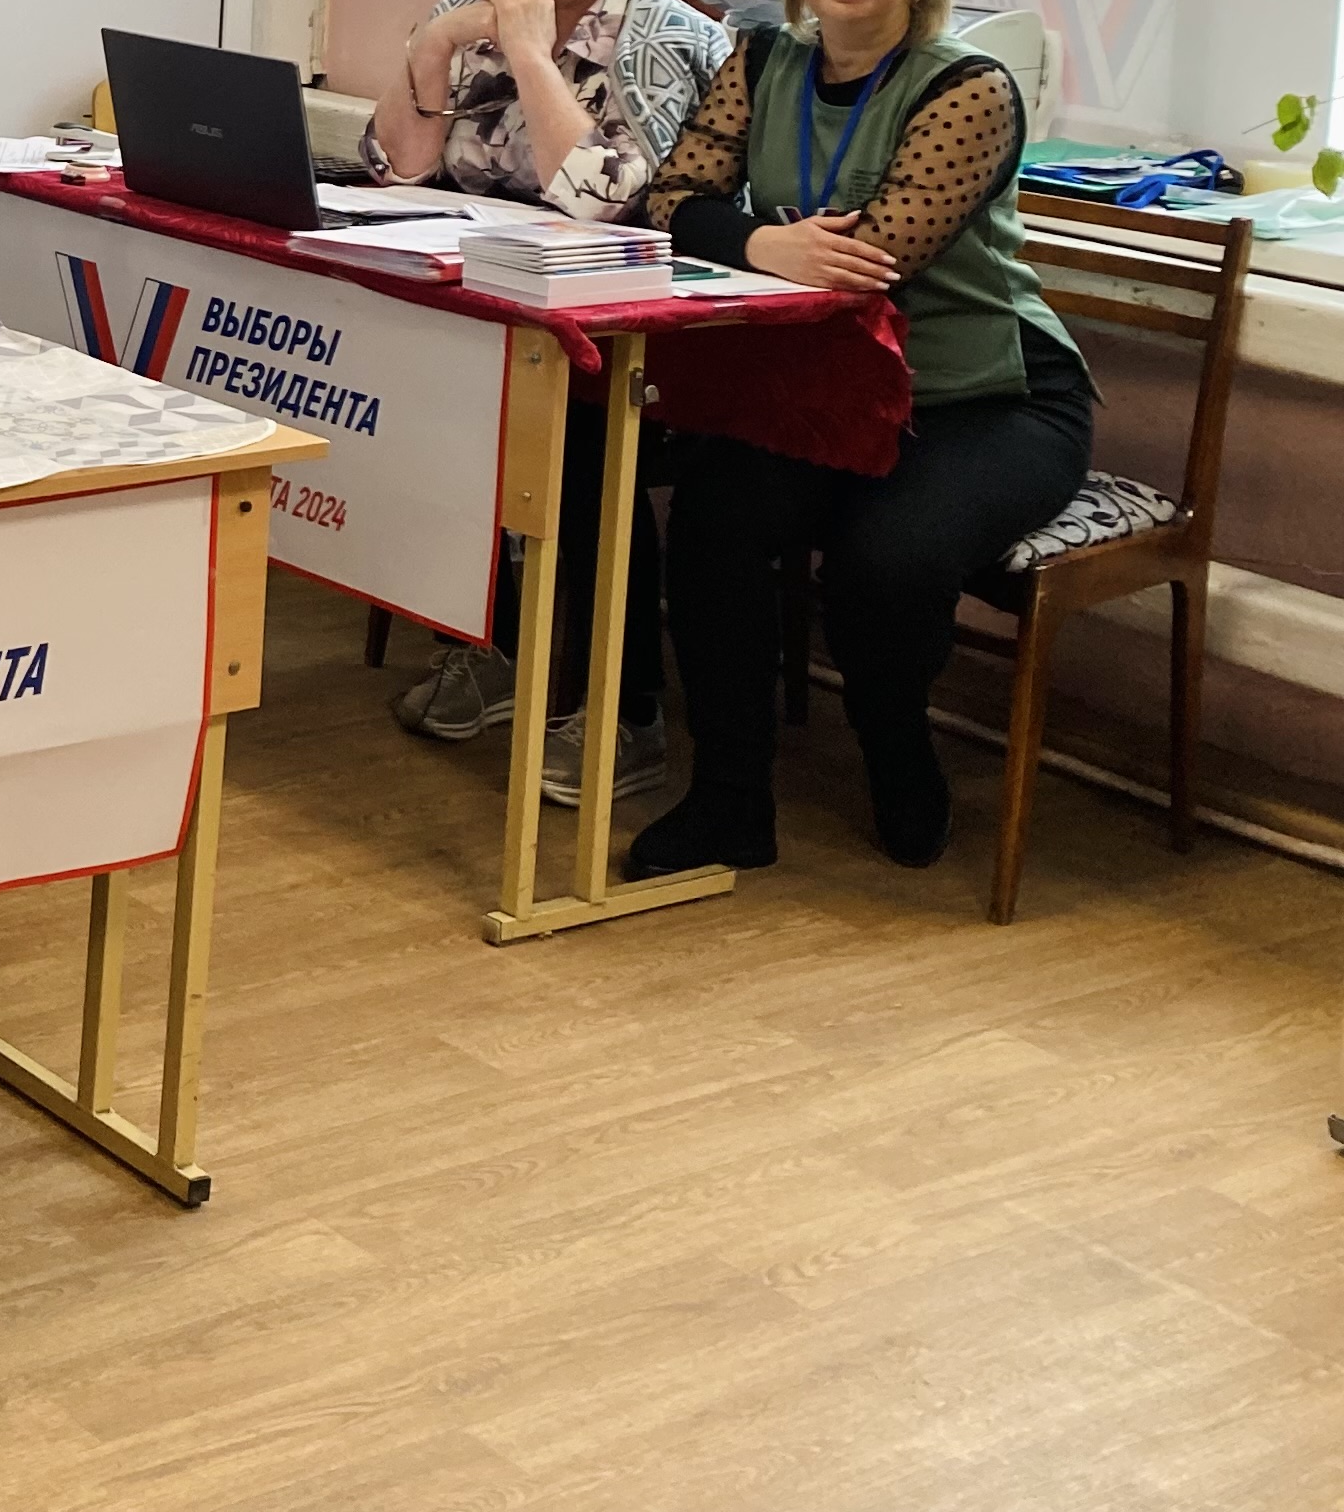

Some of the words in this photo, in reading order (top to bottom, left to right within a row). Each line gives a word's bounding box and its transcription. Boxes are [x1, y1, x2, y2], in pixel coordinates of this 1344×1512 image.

[201, 296, 343, 367] ВЫБОРЫ
[186, 346, 381, 437] ПРЕЗИДЕНТА
[292, 486, 347, 531] 2024
